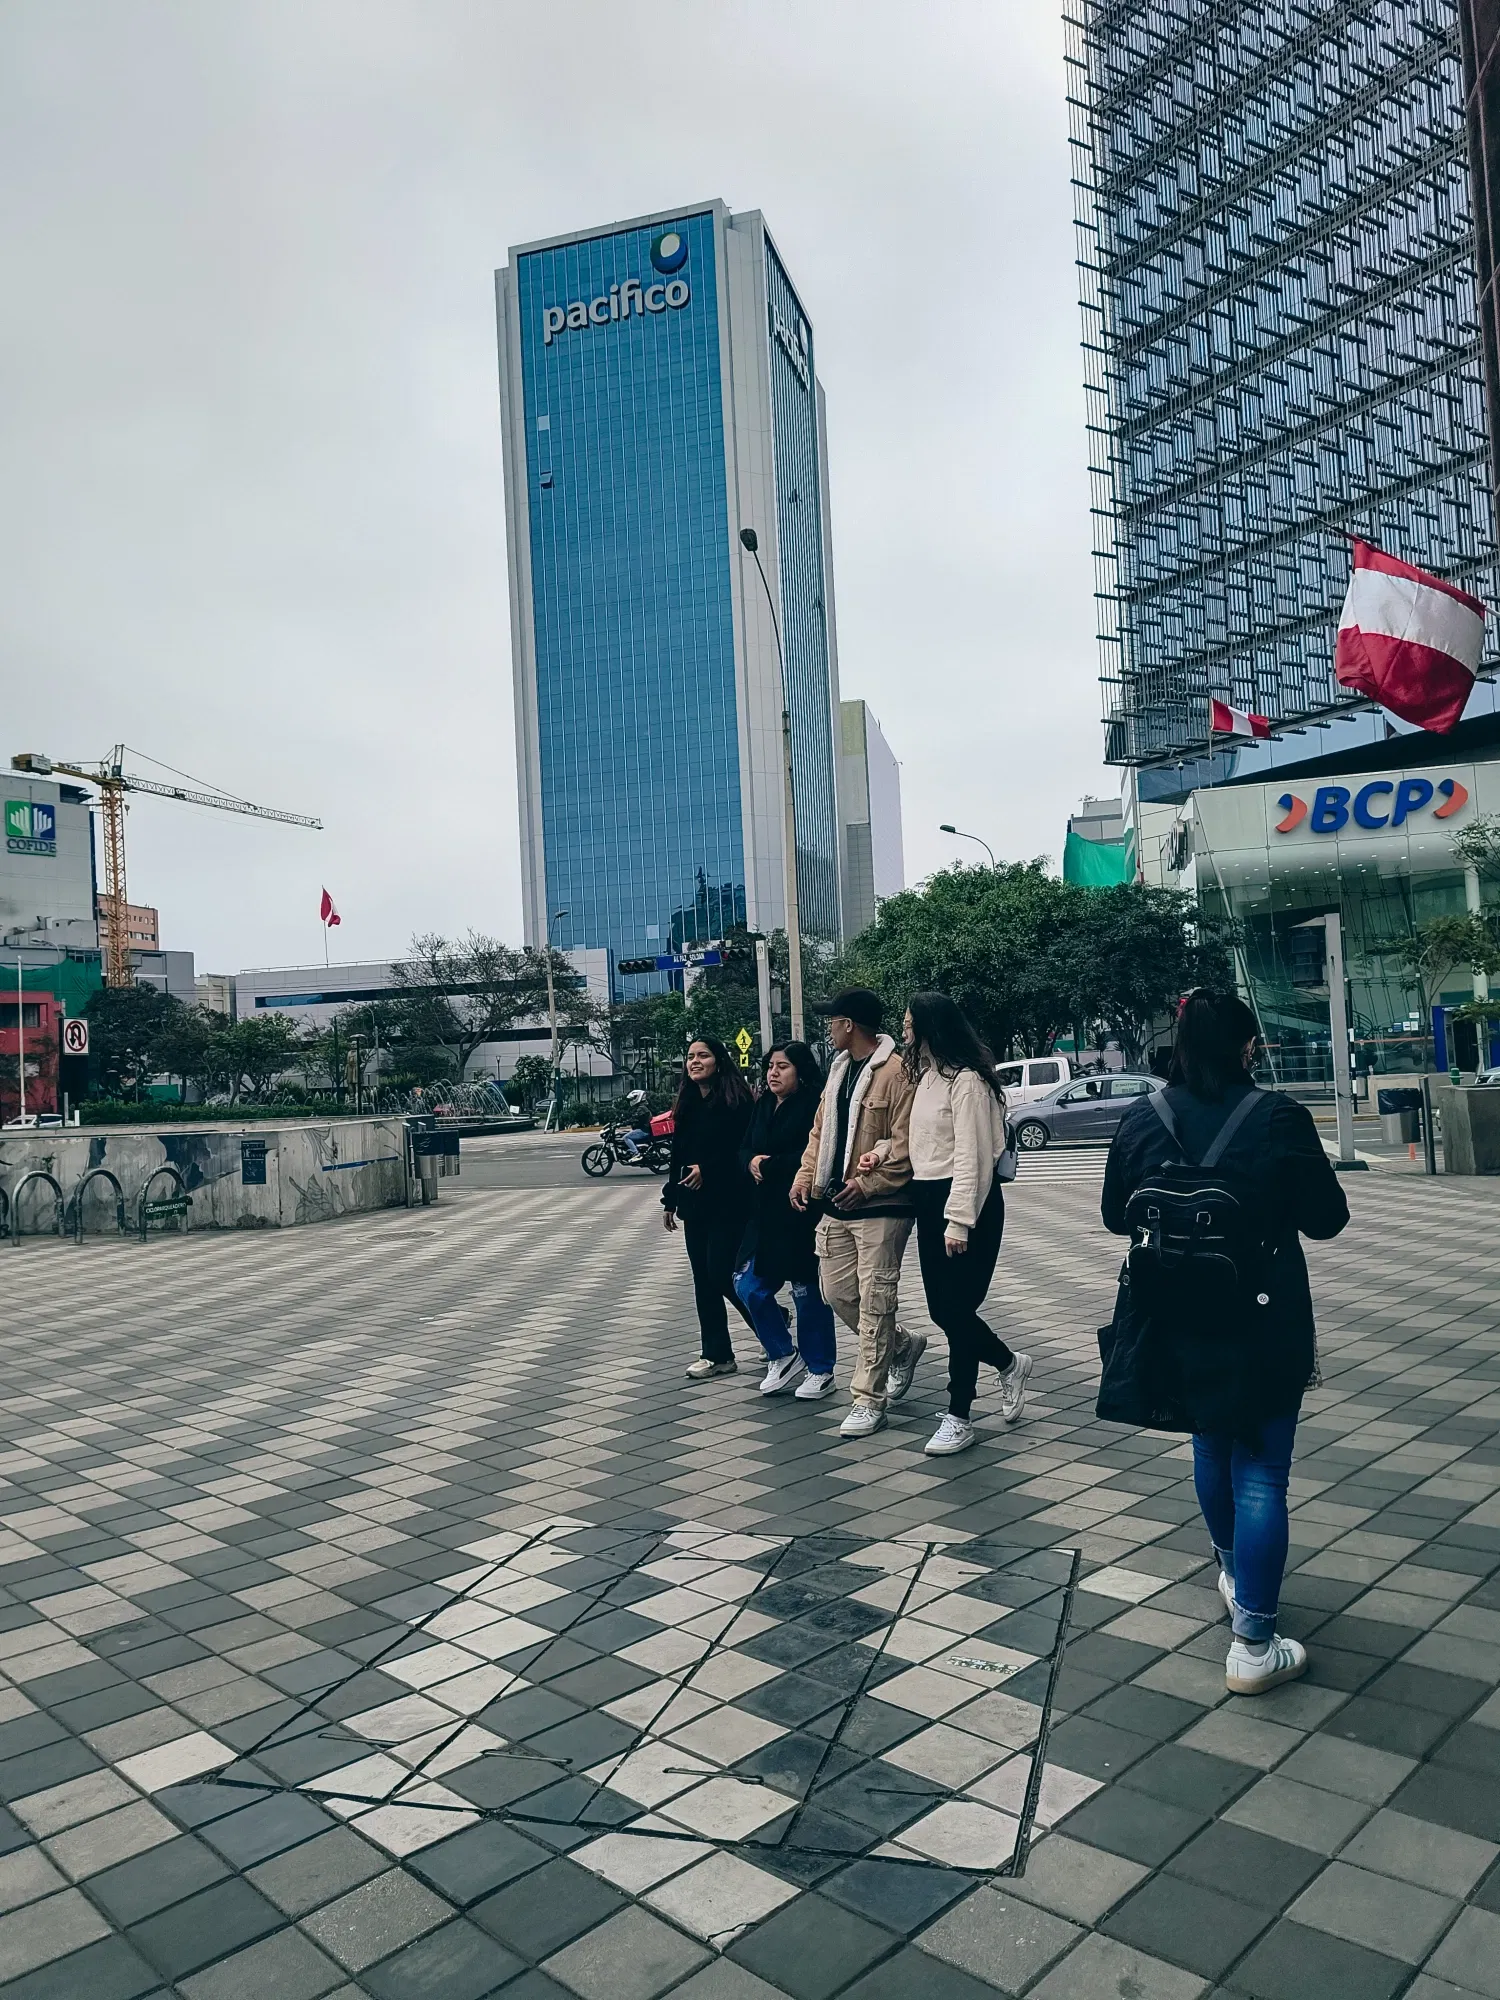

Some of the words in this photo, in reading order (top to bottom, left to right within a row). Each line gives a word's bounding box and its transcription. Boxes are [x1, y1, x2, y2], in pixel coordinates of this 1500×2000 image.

[543, 278, 689, 343] pacifico
[1311, 778, 1434, 833] BCP
[7, 838, 57, 853] COFIDE
